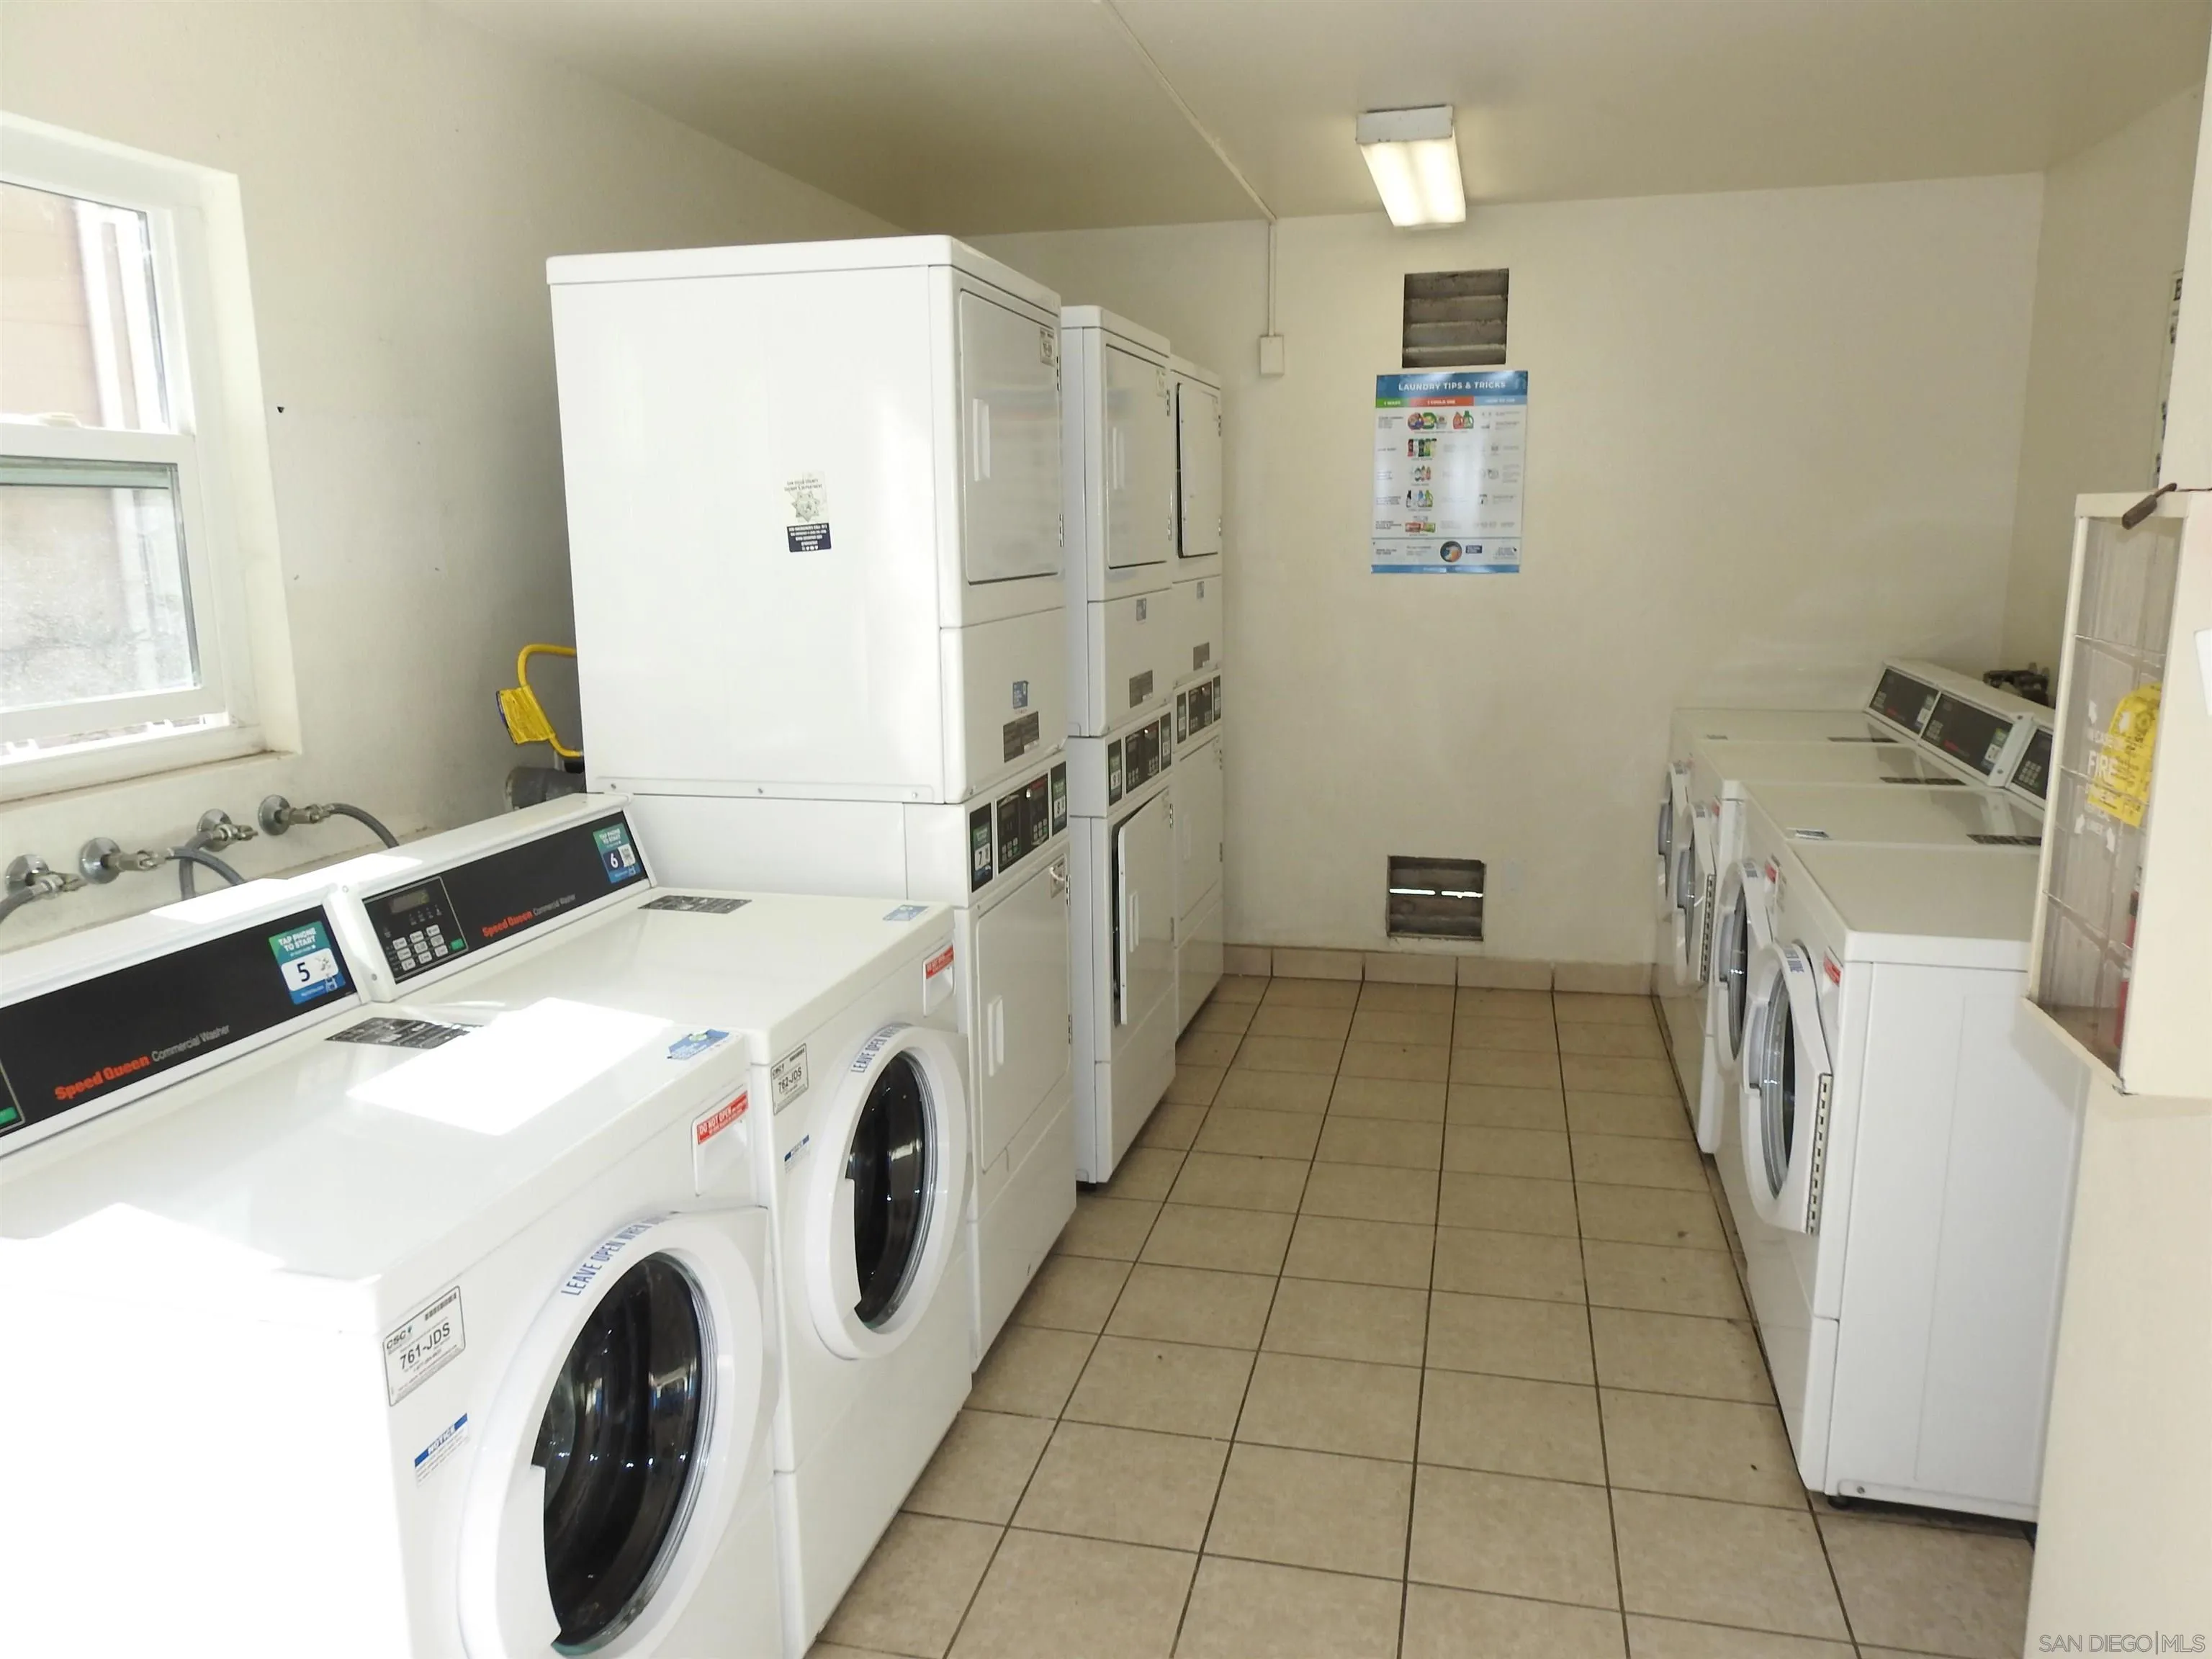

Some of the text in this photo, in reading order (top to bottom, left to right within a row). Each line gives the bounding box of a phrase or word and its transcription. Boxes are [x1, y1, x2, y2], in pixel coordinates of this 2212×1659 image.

[611, 853, 619, 868] 6
[482, 919, 508, 938] Speed
[507, 911, 533, 926] Queen
[278, 935, 292, 945] TAP
[284, 943, 295, 952] TO
[295, 935, 315, 949] START
[297, 961, 310, 982] 5
[55, 1025, 230, 1100] Speed Queen Commercial Washer
[561, 1262, 602, 1295] LEAVE
[590, 1241, 626, 1262] OPEN
[387, 1330, 406, 1349] CSC
[400, 1322, 450, 1370] 761-JDS
